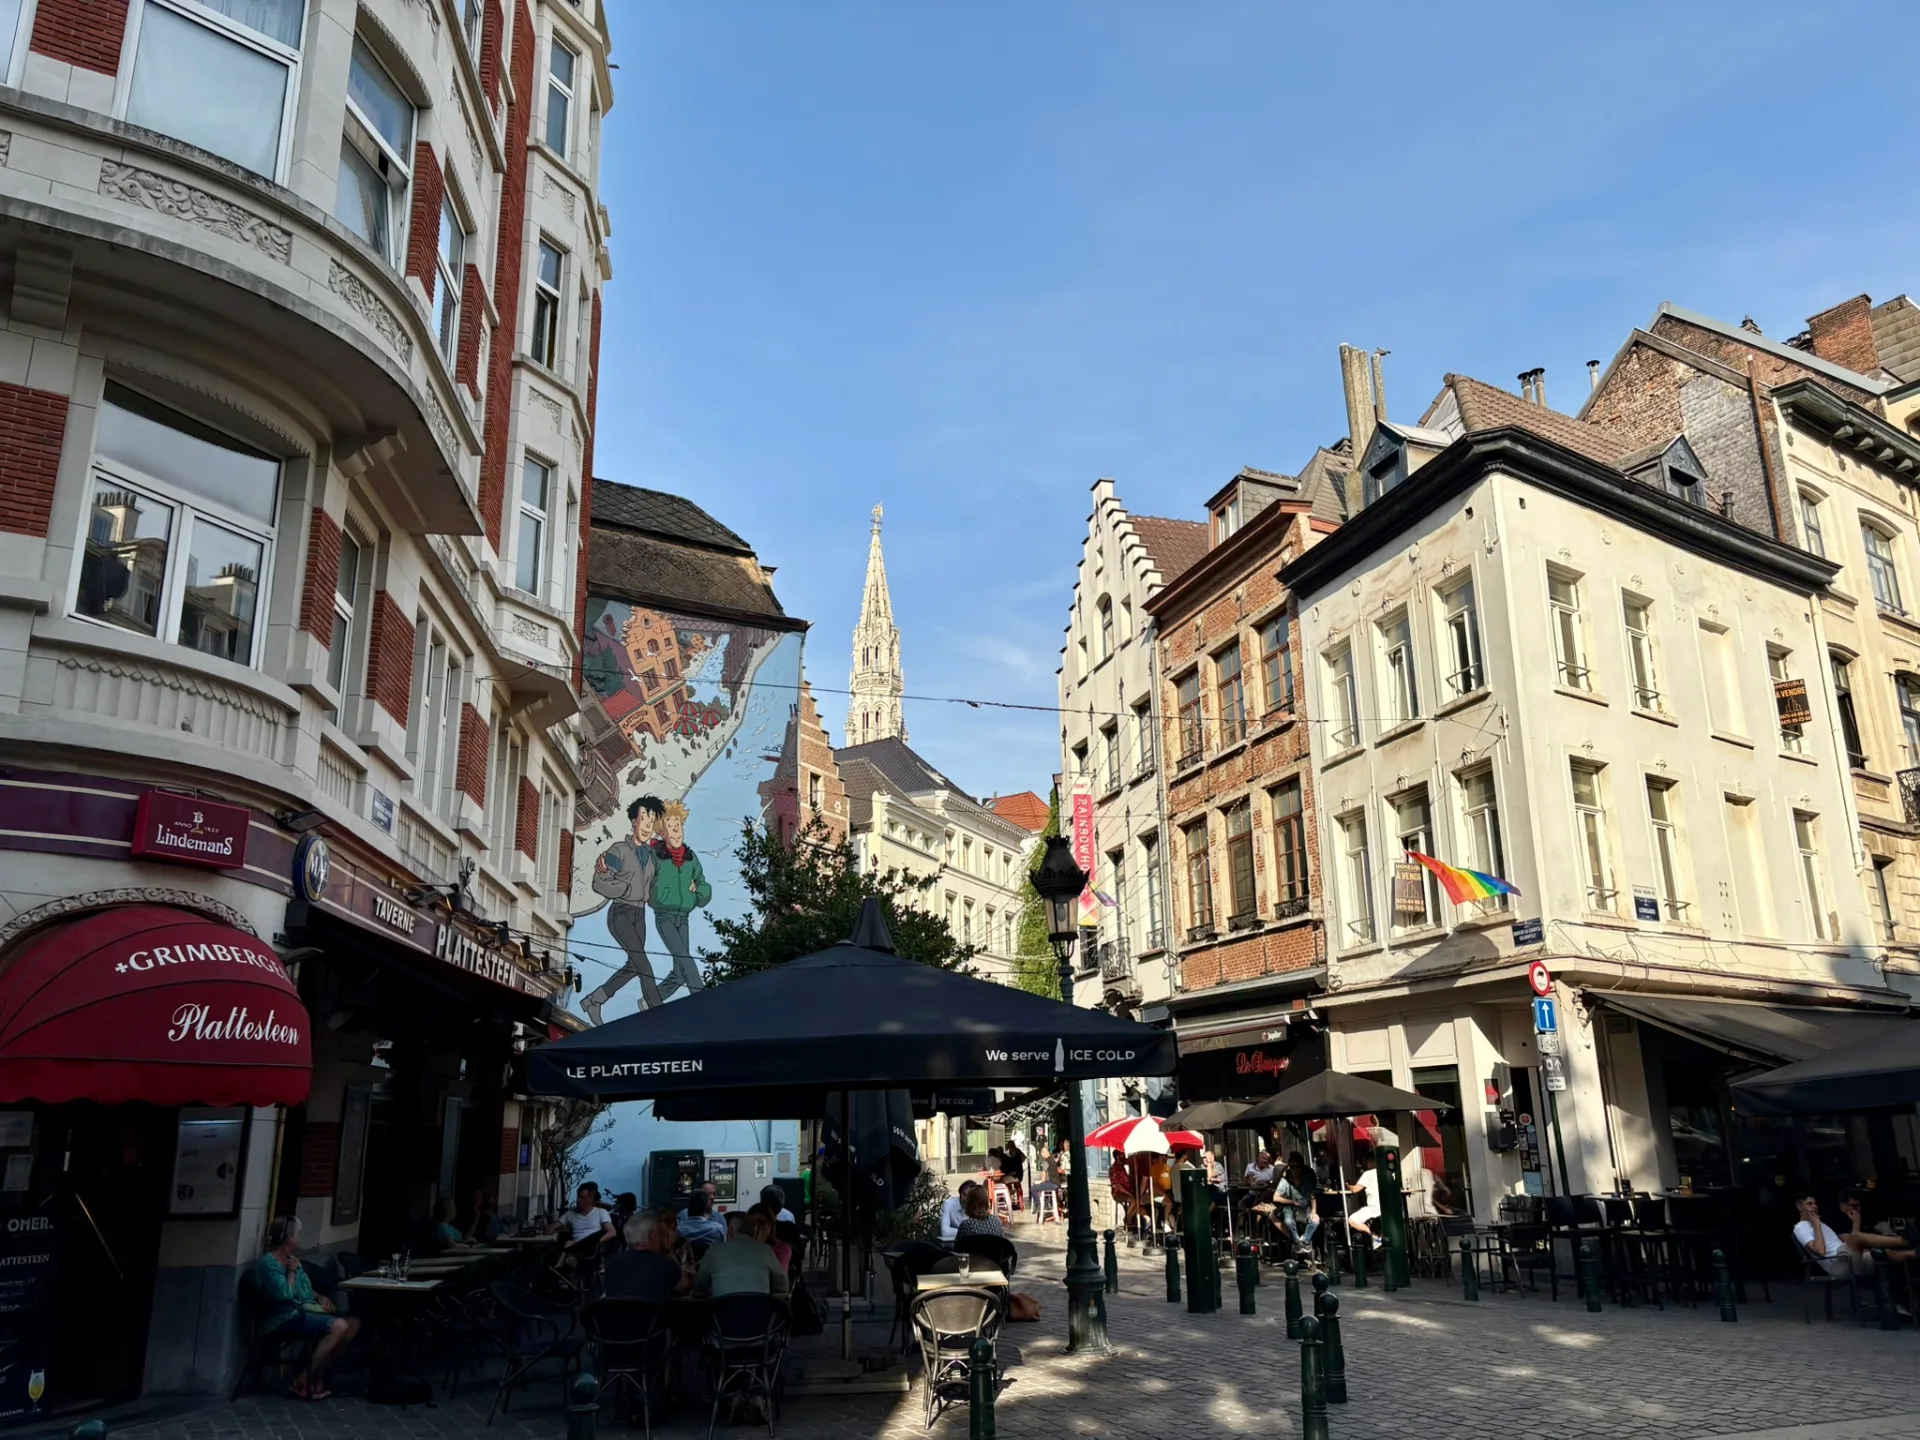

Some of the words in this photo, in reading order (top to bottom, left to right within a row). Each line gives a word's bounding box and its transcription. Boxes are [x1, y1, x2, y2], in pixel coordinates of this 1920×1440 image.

[1780, 687, 1806, 698] VENDRE
[174, 820, 193, 829] ANNO
[1078, 798, 1091, 898] RAINBOWHOE
[375, 896, 416, 934] TAVERNE
[436, 924, 517, 988] PLATTESTEEN
[168, 1003, 300, 1045] Plattesteen
[985, 1050, 1008, 1061] We
[1011, 1051, 1050, 1061] serve
[1069, 1050, 1093, 1061] ICE
[1096, 1050, 1136, 1061] COLD
[566, 1067, 587, 1079] LE
[591, 1059, 703, 1078] PLATTESTEEN
[938, 1097, 951, 1105] ICE
[892, 1125, 905, 1138] We
